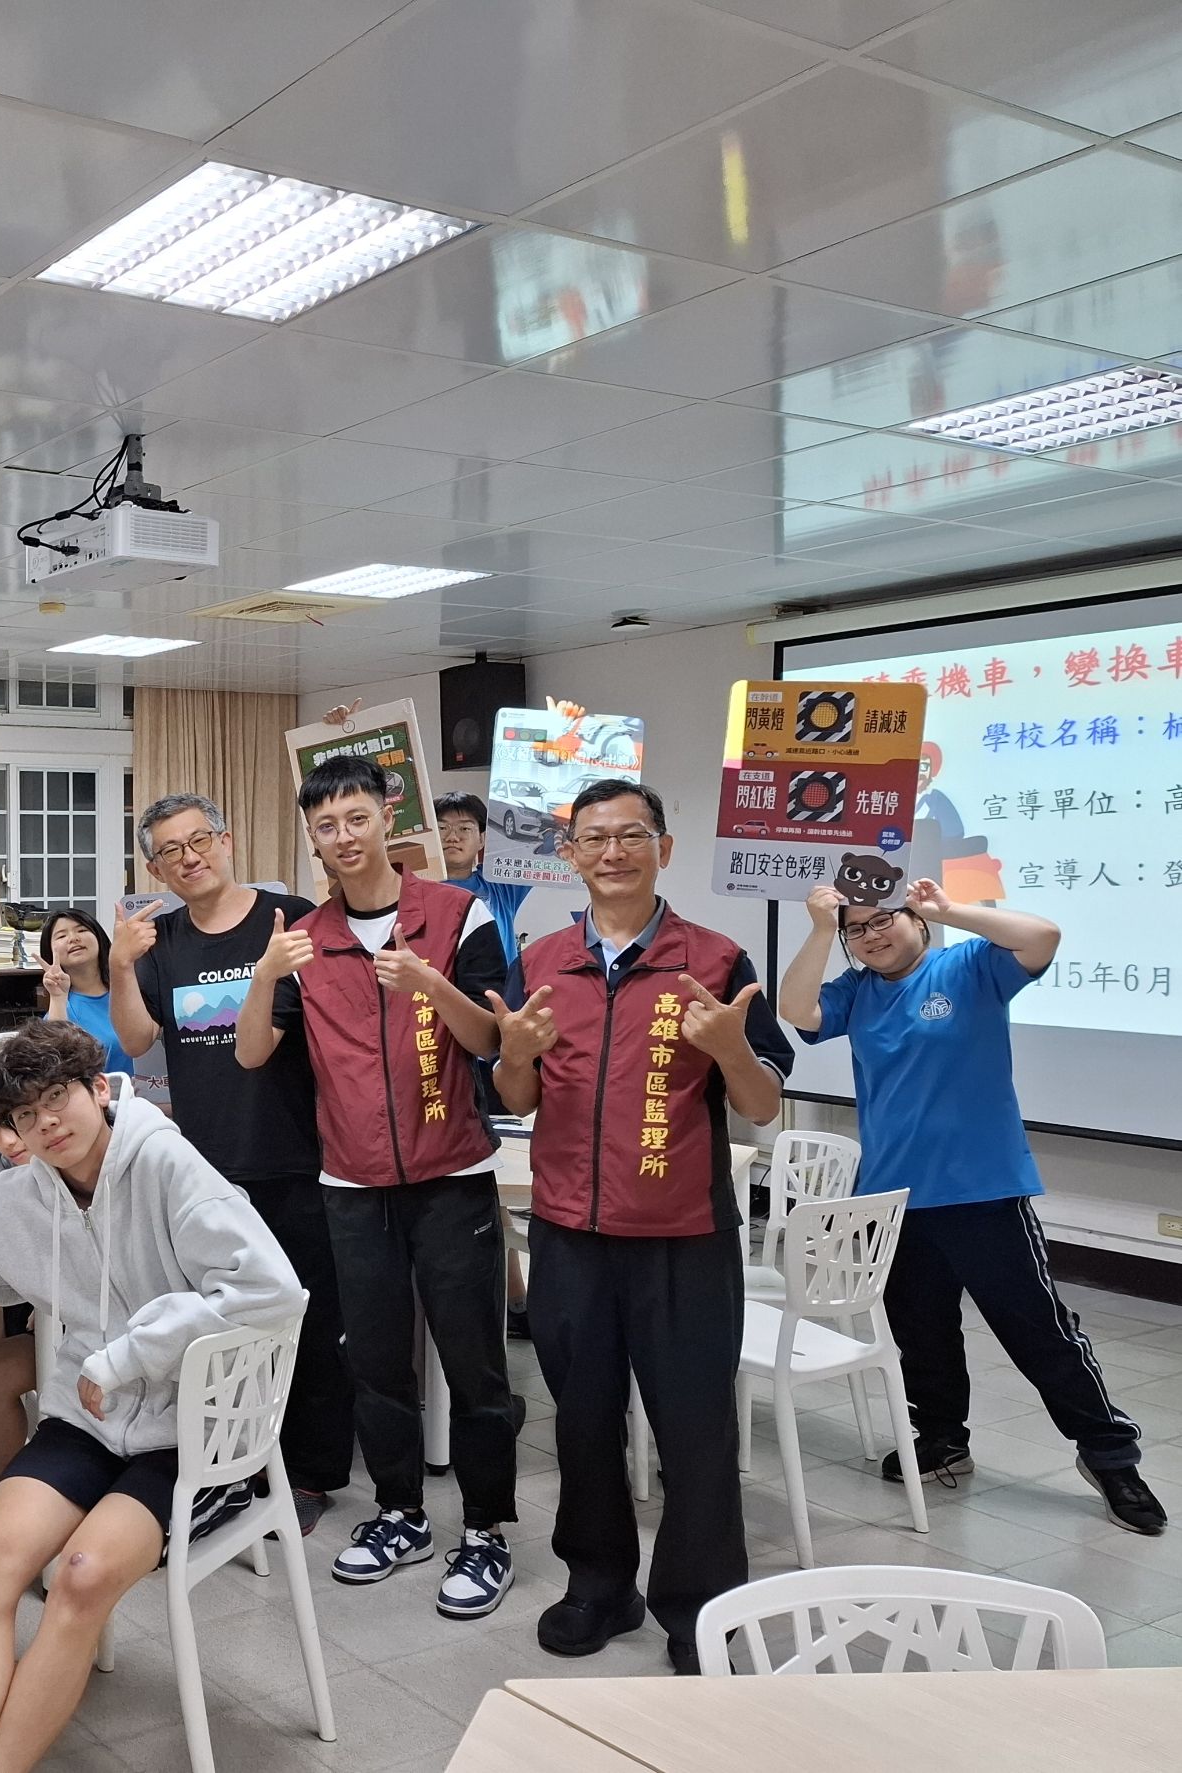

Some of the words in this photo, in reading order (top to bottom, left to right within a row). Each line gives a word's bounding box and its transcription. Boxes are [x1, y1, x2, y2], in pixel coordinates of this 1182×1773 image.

[745, 707, 785, 731] 閃黃燈
[864, 709, 908, 734] 請減速
[742, 772, 772, 781] 在支道
[735, 785, 777, 810] 閃紅燈
[855, 790, 900, 816] 先暫停
[729, 851, 826, 880] 路口安全色彩學
[181, 1034, 219, 1043] MOUNTAINS
[412, 959, 447, 1124] 市區監理所
[639, 992, 682, 1179] 高雄市區監理所
